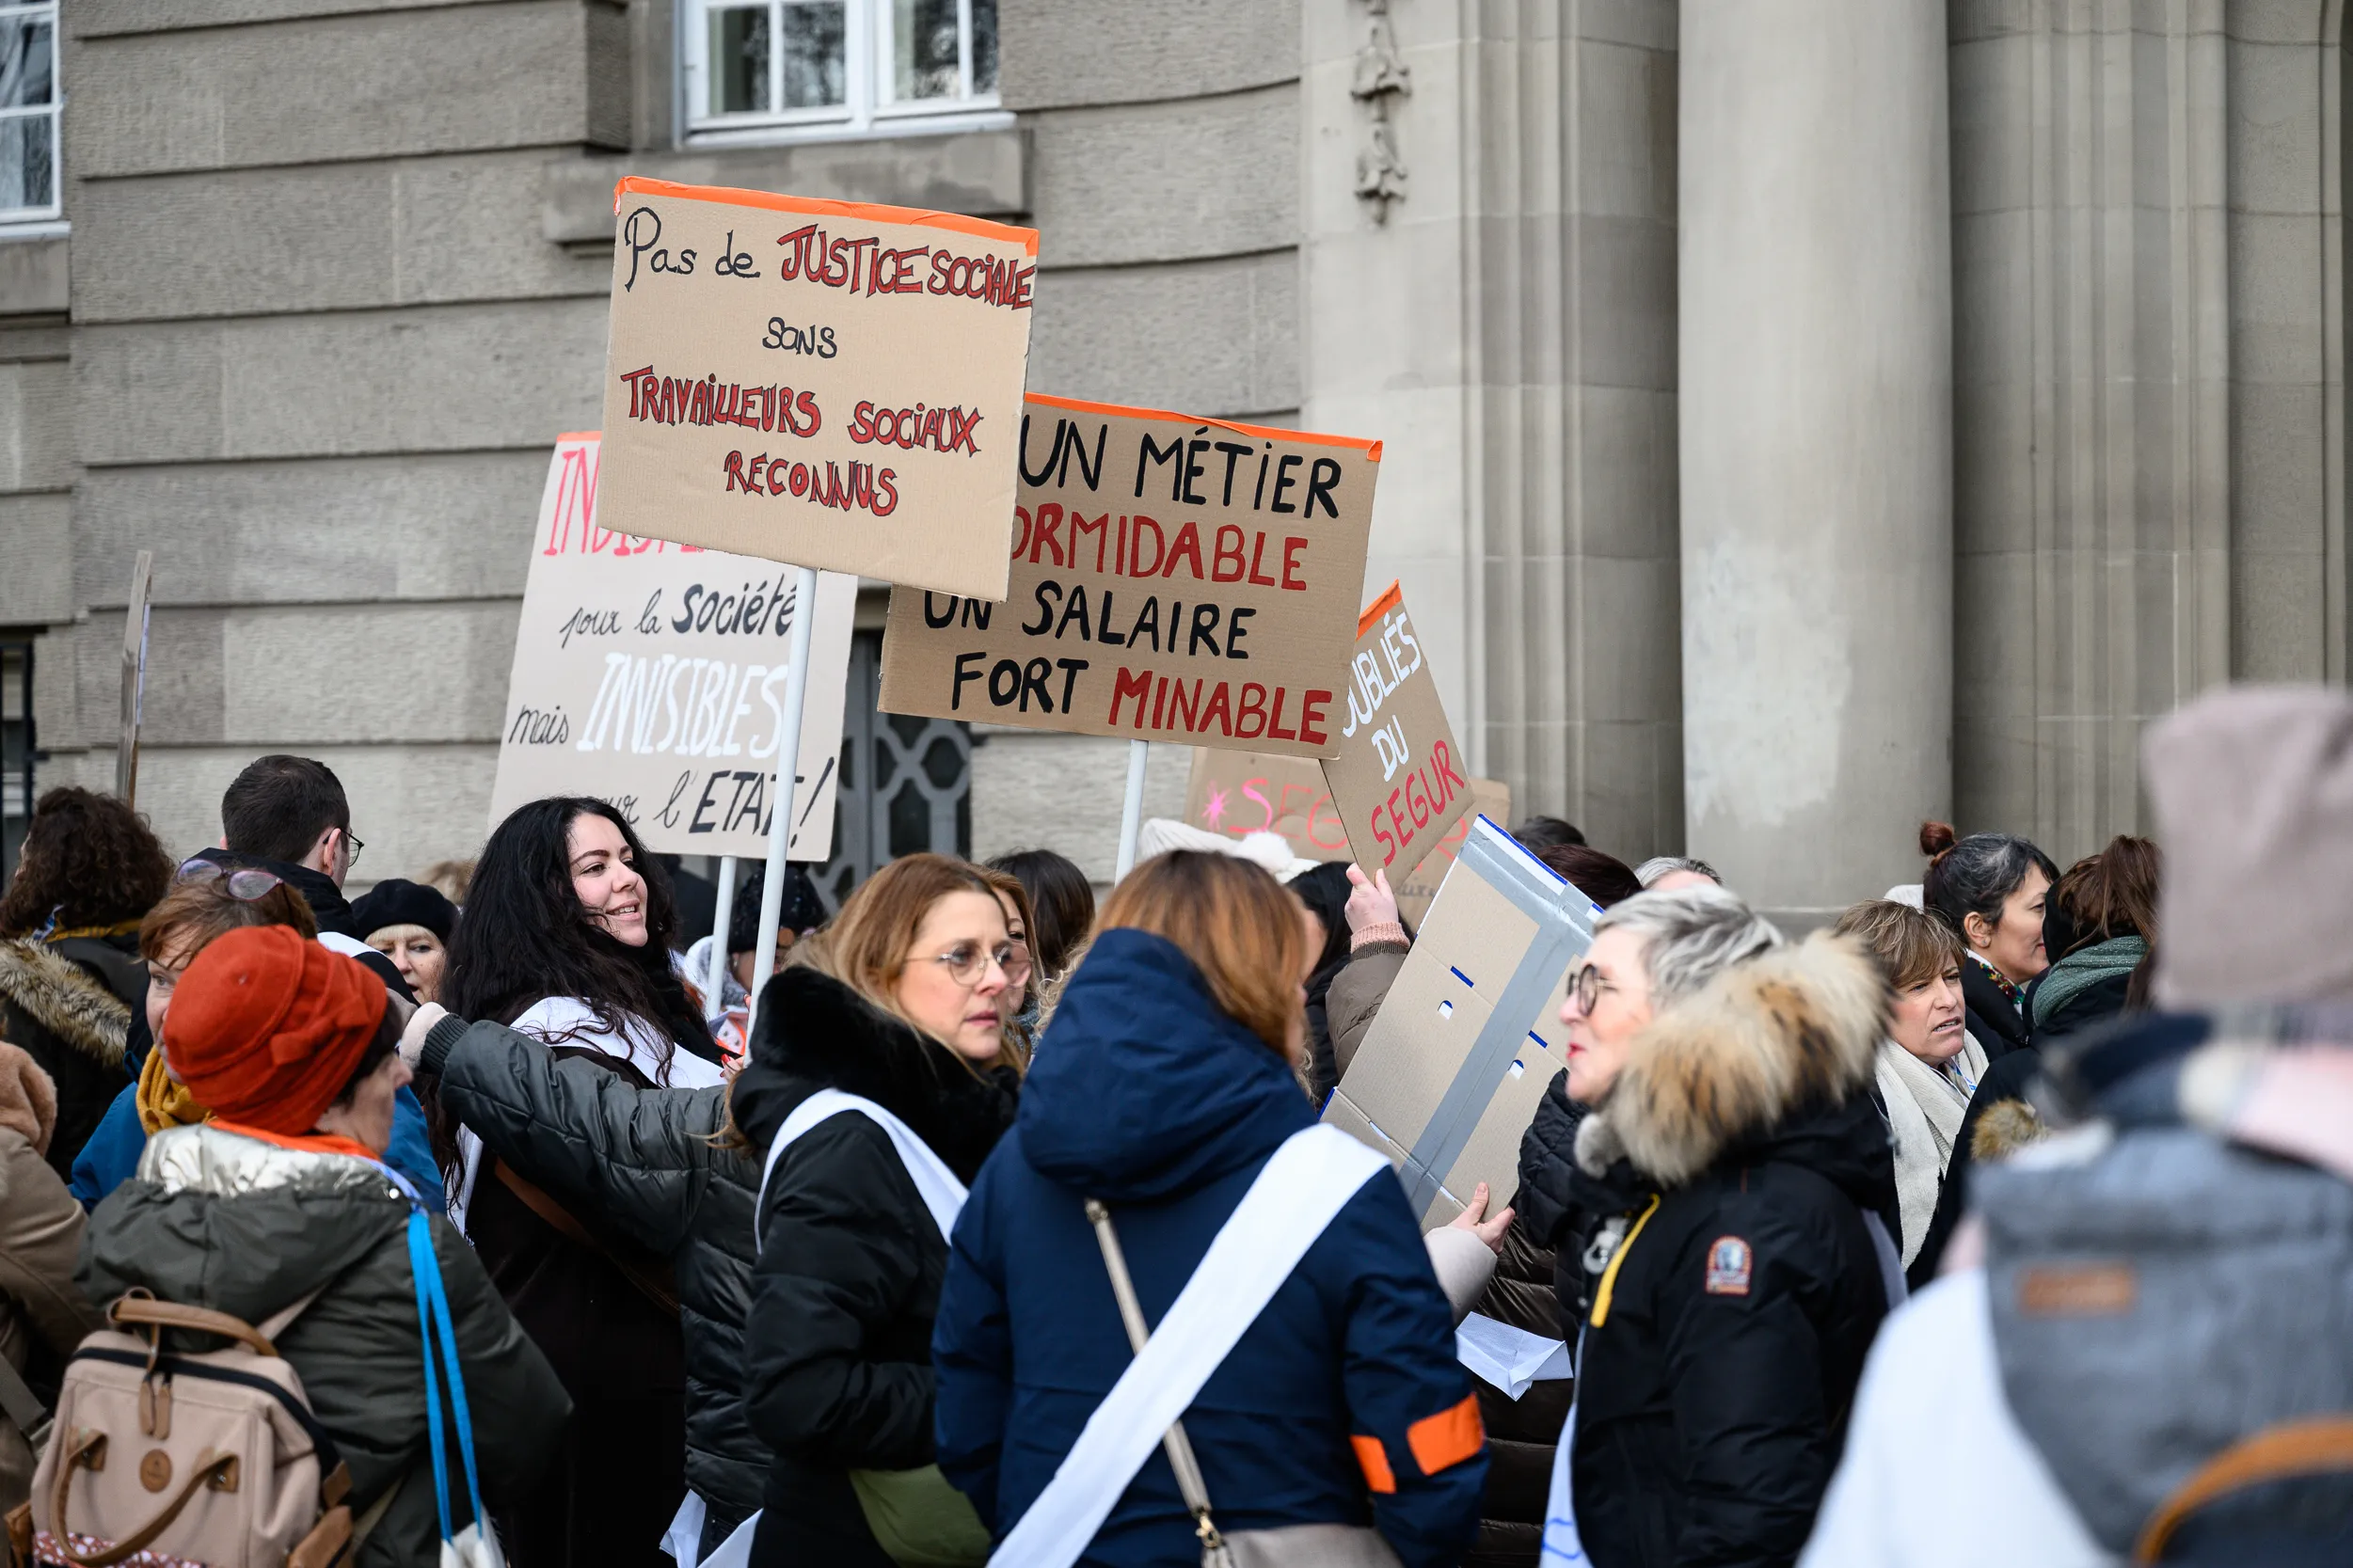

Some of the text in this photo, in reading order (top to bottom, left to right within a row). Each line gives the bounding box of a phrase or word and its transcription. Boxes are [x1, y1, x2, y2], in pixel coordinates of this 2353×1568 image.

[624, 206, 696, 293] Pas
[715, 230, 760, 278] de
[776, 224, 930, 297] JUSTICE
[723, 450, 898, 517] RECONNUS
[1020, 414, 1107, 491] UN
[559, 607, 621, 649] pour
[634, 588, 661, 635] la
[924, 579, 1256, 659] UN SALAIRE
[509, 652, 789, 759] mais INVISIBLES
[951, 651, 1332, 745] FORT MINABLE
[1371, 715, 1410, 783] DU
[1371, 740, 1465, 867] SEGUR
